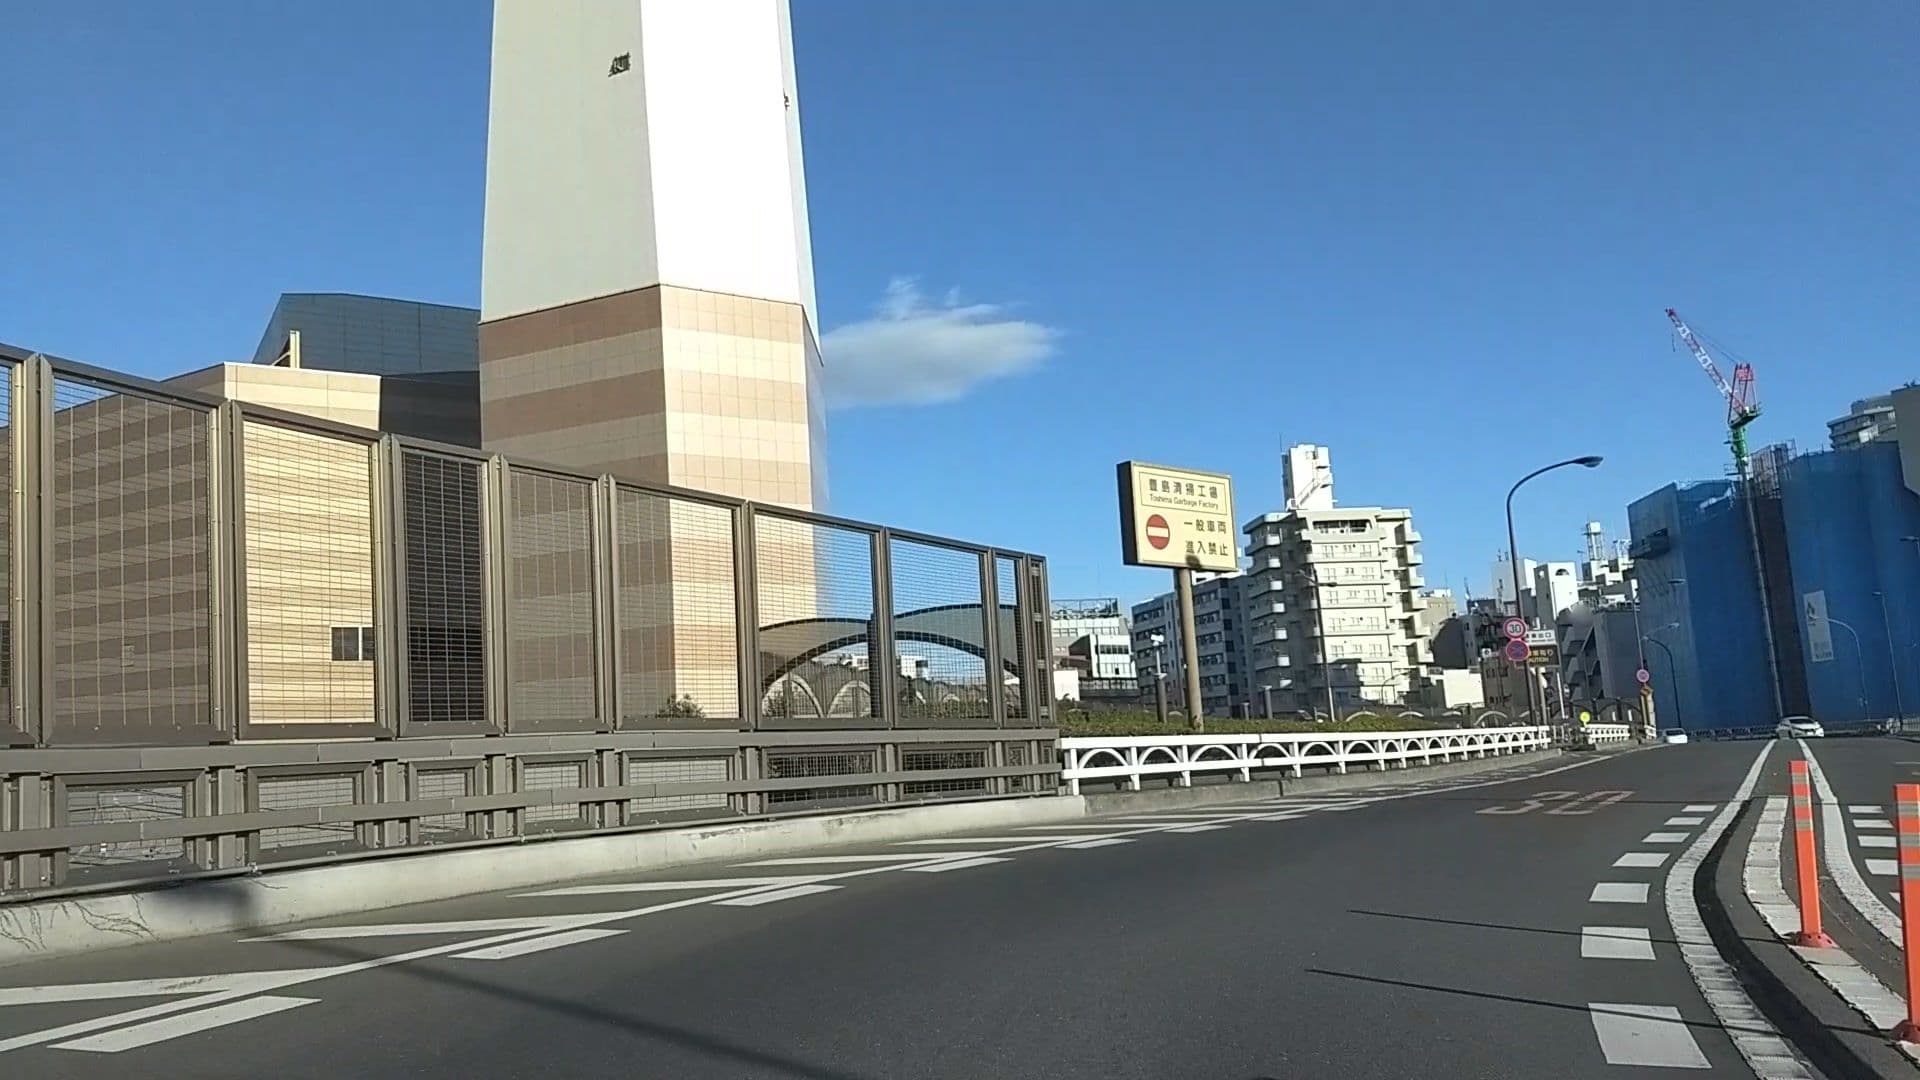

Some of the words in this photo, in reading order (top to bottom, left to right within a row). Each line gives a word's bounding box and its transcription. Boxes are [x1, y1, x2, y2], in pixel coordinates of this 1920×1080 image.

[1149, 493, 1173, 504] Toshima
[1173, 496, 1198, 508] Garbage
[1198, 499, 1219, 510] Factory
[1184, 519, 1227, 534] 一般車両
[1185, 540, 1229, 556] 進入禁止
[1509, 624, 1521, 633] 30
